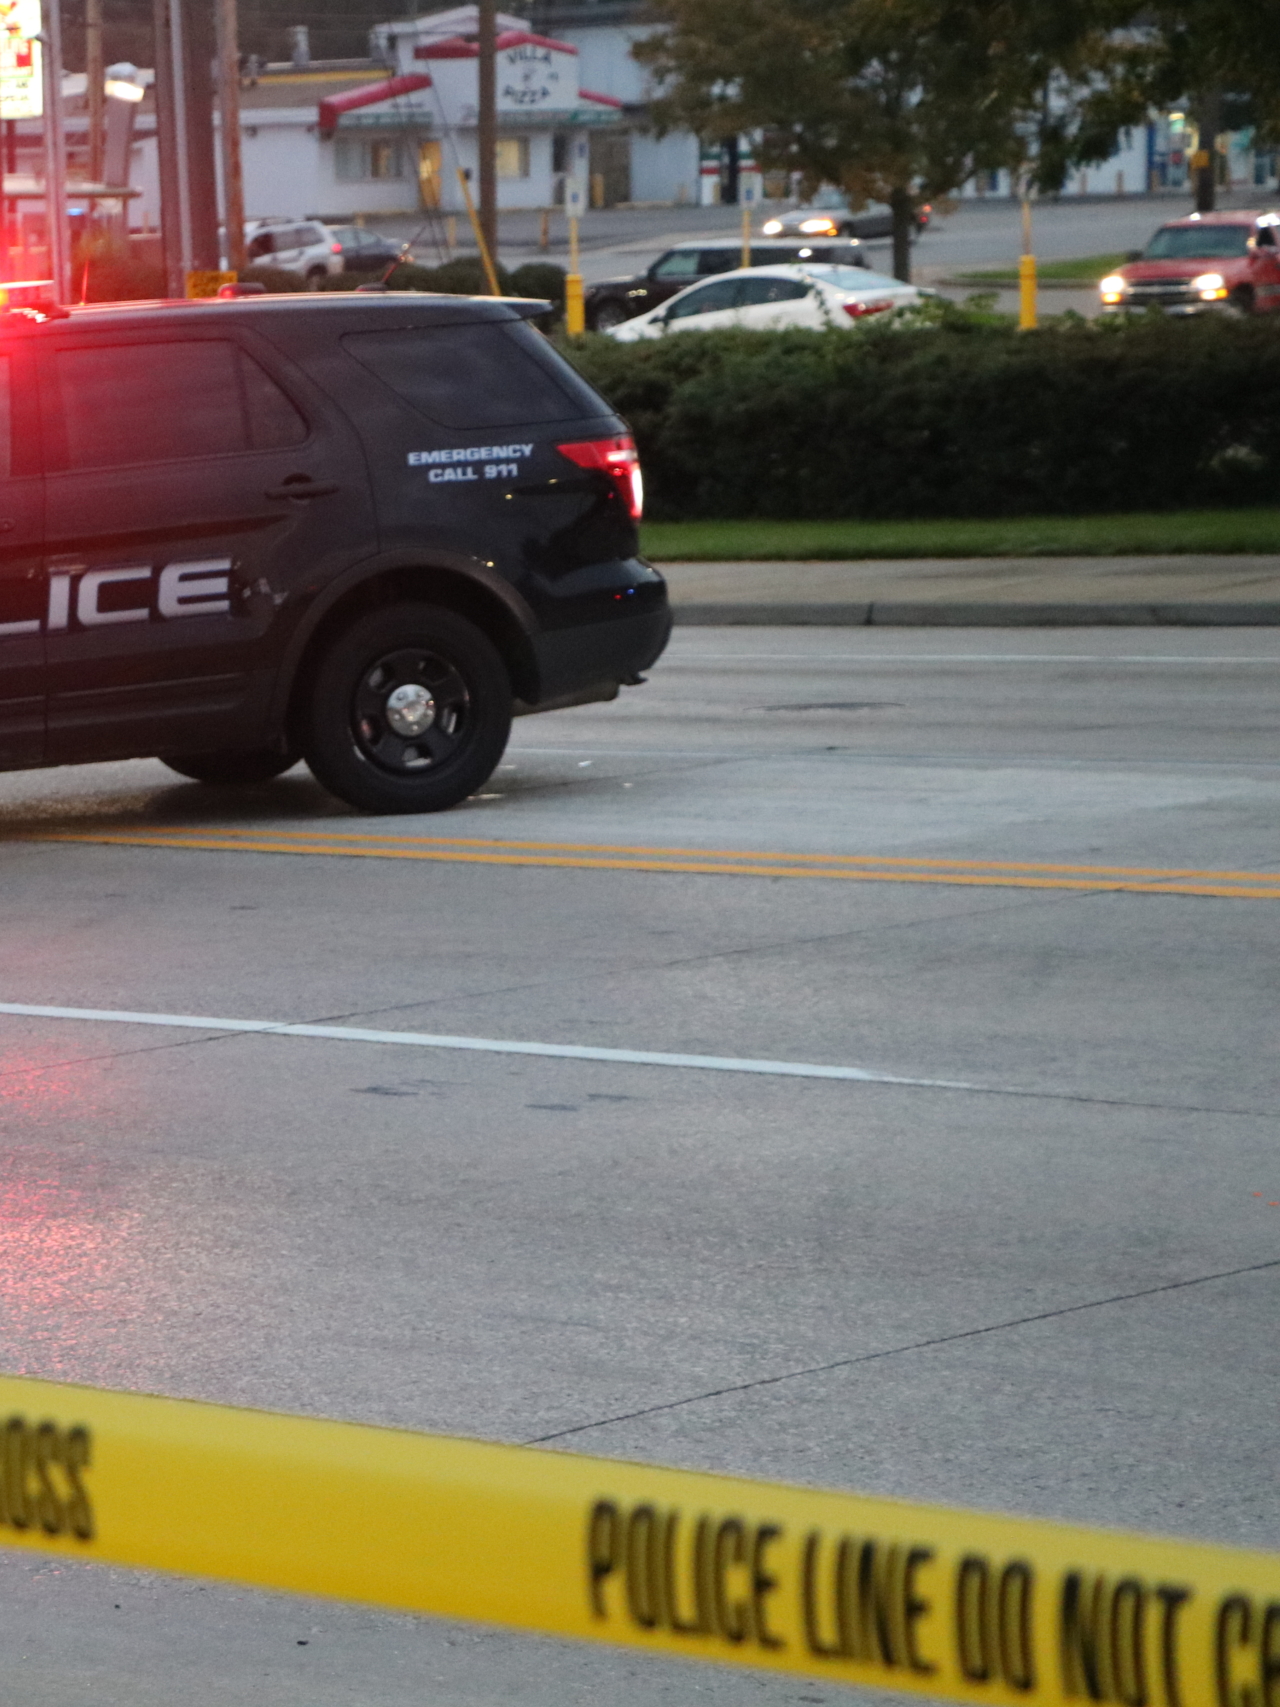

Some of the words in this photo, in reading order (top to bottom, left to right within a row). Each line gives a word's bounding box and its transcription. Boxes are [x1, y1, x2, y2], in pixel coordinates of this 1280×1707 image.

[503, 84, 550, 104] PIZZA
[407, 443, 534, 466] EMERGENCY
[428, 466, 478, 483] CALL
[484, 462, 519, 480] 911
[588, 1497, 785, 1653] POLICE
[799, 1526, 940, 1676] LINE
[1058, 1567, 1195, 1707] NOT
